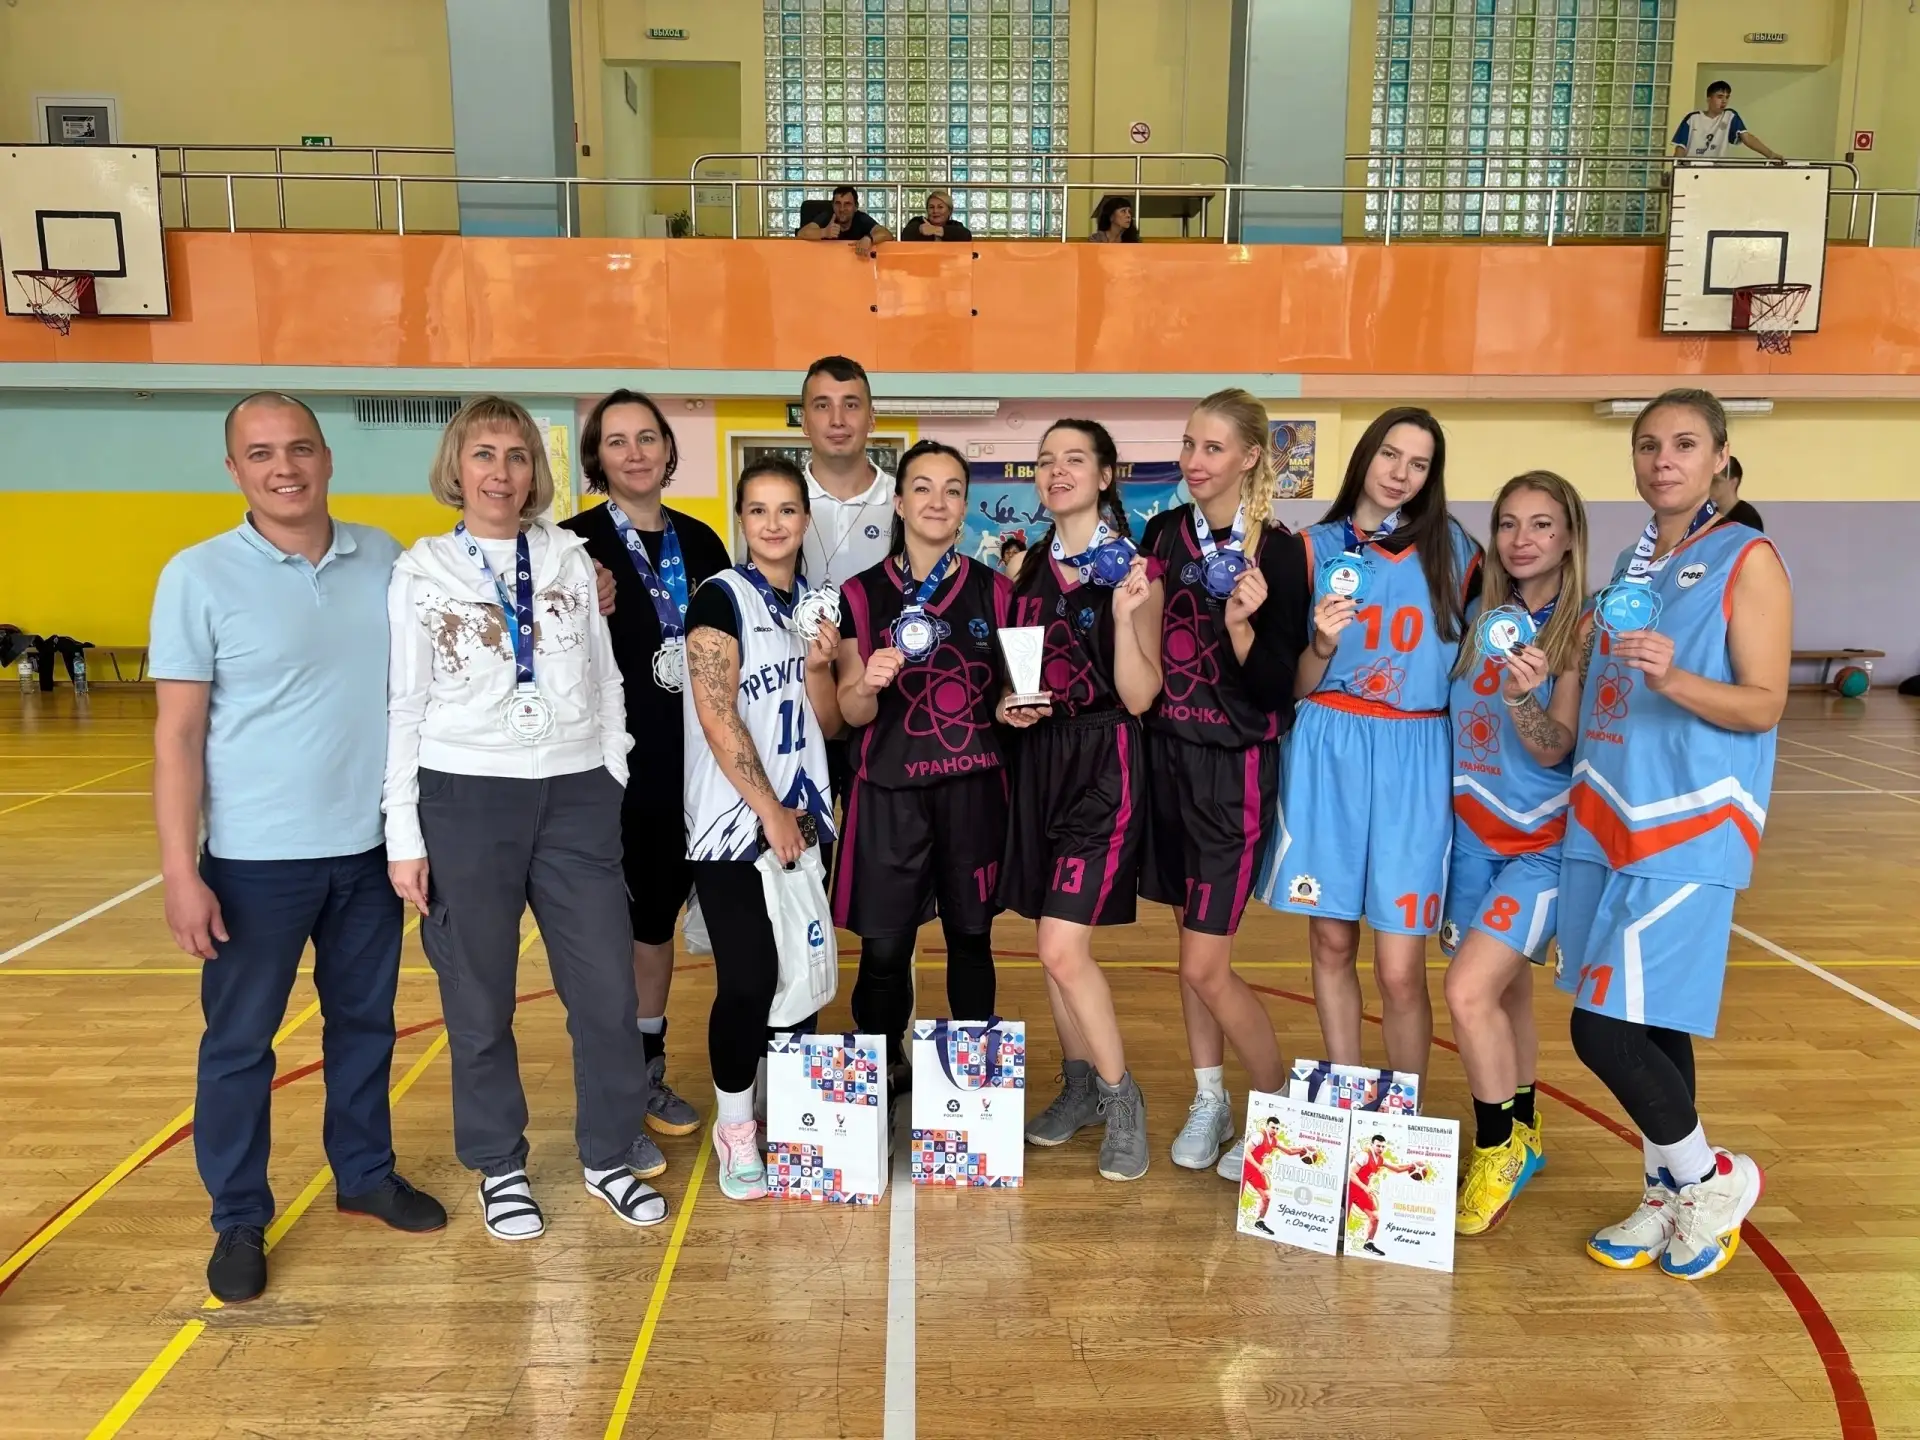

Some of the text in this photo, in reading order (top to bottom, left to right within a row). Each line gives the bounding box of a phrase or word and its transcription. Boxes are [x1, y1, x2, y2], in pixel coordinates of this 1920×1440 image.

[653, 28, 680, 37] ВЫХОД
[1755, 32, 1783, 41] ВЫХОД
[1289, 458, 1310, 466] МАЯ
[1004, 463, 1014, 478] Я
[1680, 571, 1703, 580] РФБ
[1354, 604, 1424, 653] 10
[1473, 656, 1507, 696] 8
[1052, 856, 1086, 894] 13
[1395, 893, 1440, 929] 10
[1482, 894, 1521, 933] 8
[1300, 1109, 1344, 1123] БАСКЕТБОЛЬНЫЙ
[1407, 1124, 1453, 1135] БАСКЕТБОЛЬНЫЙ
[1272, 1162, 1339, 1191] ДИПЛОМ
[1277, 1203, 1335, 1225] Ураночка-2
[1393, 1202, 1437, 1215] ПОБЕДИТЕЛЬ
